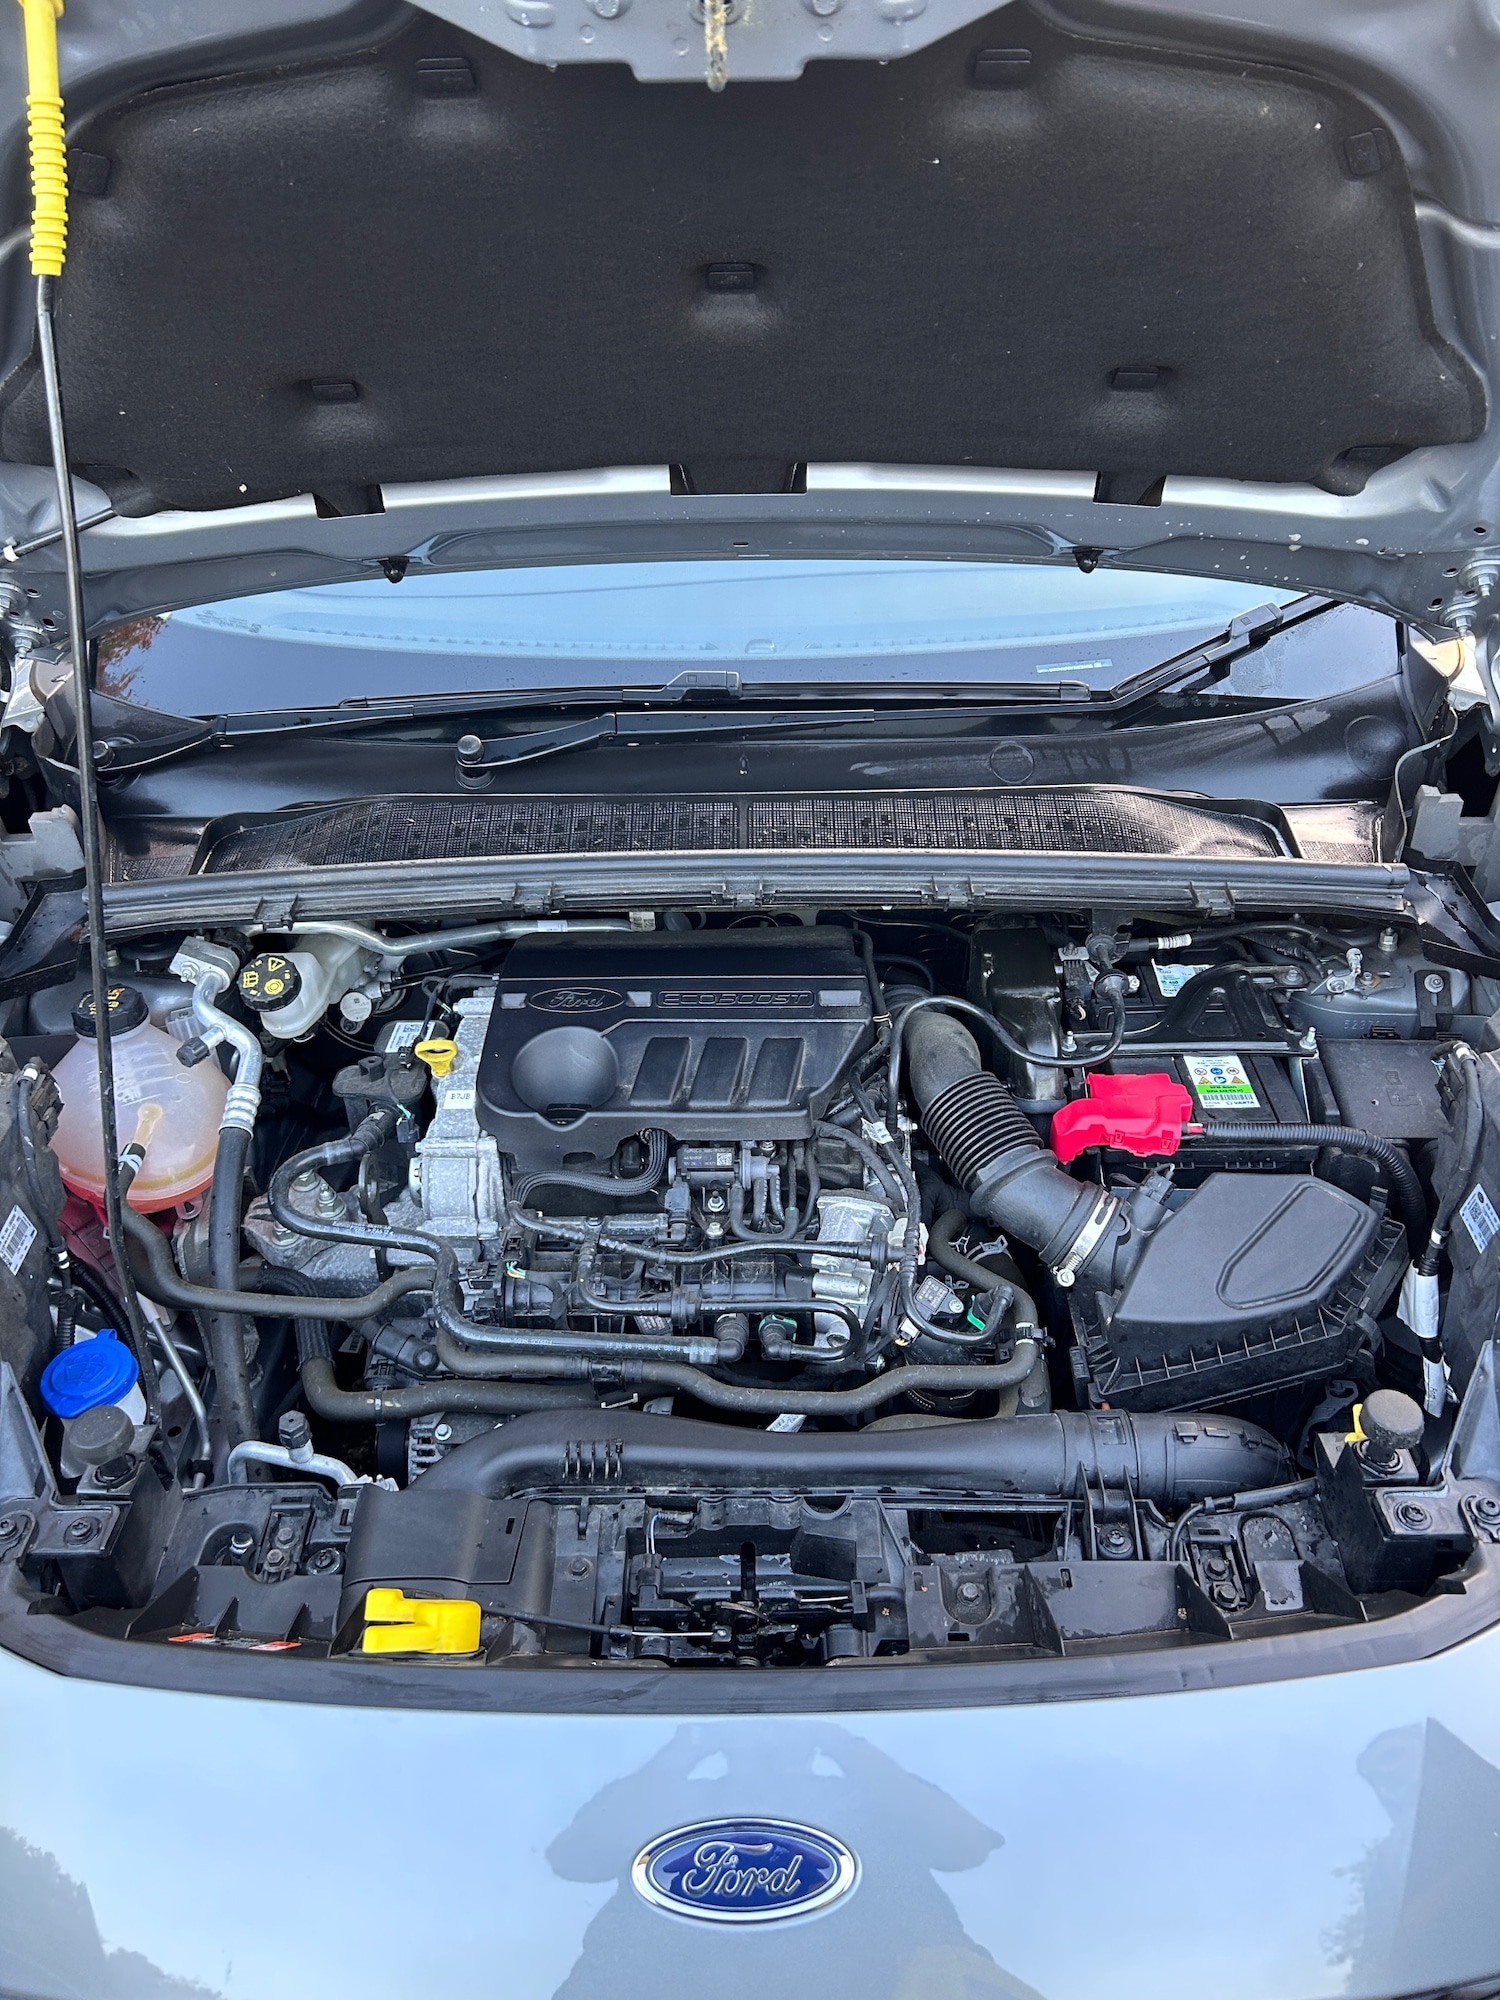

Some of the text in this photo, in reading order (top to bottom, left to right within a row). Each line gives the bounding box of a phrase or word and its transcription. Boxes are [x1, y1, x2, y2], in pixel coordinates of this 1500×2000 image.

[548, 990, 606, 1008] Ford
[662, 993, 809, 1006] ECOBOOST
[681, 1840, 803, 1898] Ford
